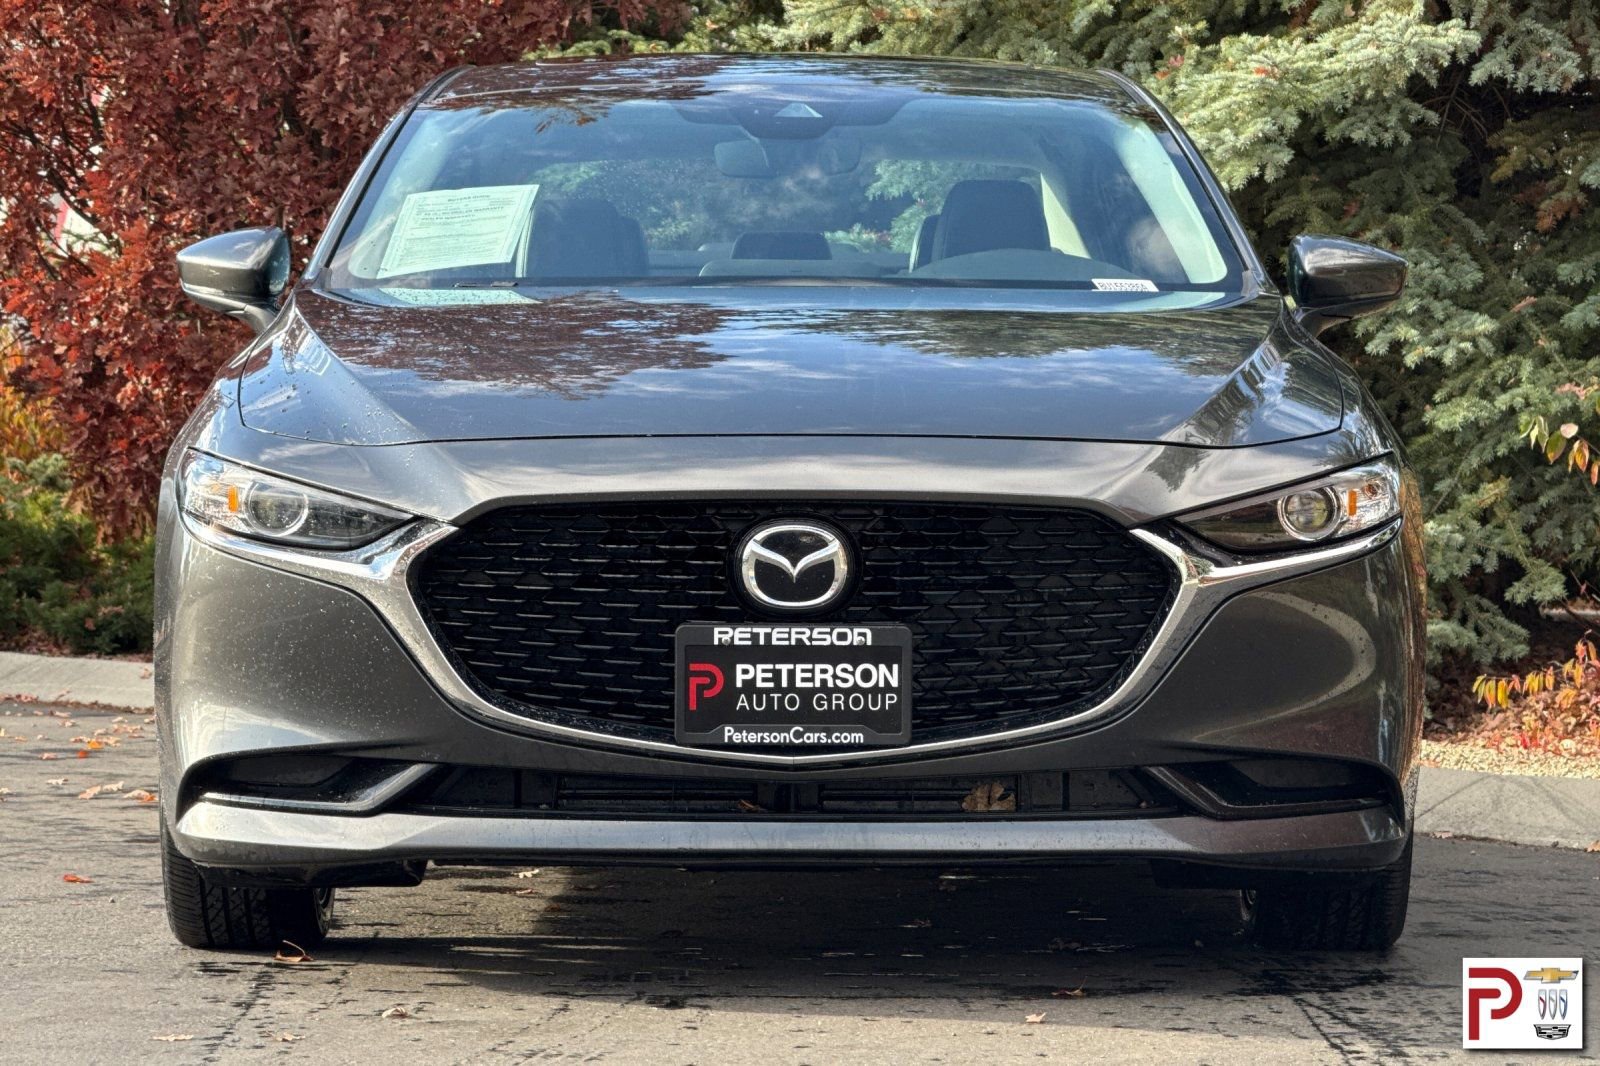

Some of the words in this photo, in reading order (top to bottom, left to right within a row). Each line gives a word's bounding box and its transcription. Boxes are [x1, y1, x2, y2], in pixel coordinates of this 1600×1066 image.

[713, 627, 872, 646] PETERSON
[735, 663, 899, 688] PETERSON
[735, 693, 800, 711] AUTO
[812, 693, 898, 711] GROUP
[724, 726, 864, 744] PetersonCars.com
